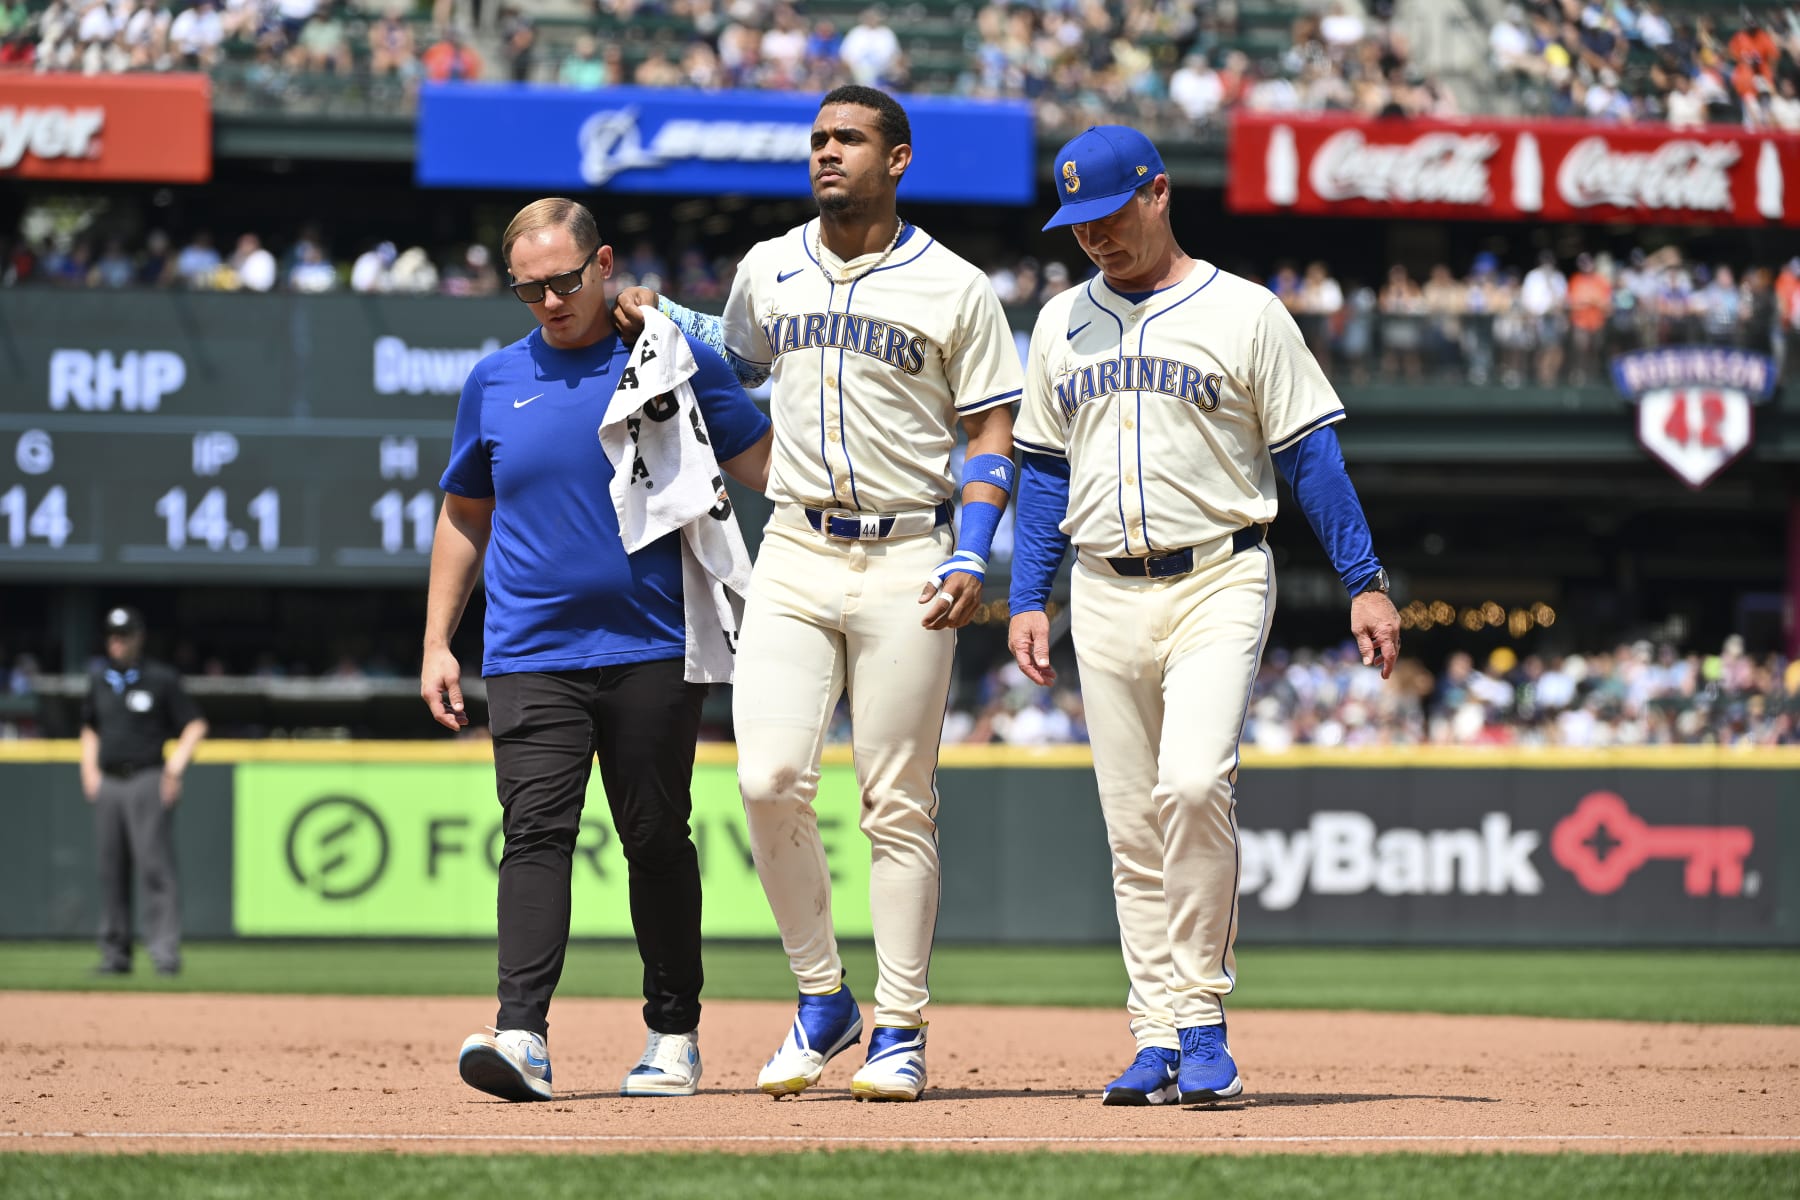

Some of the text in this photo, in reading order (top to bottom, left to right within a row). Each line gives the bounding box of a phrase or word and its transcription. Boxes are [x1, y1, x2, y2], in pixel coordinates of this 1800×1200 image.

[762, 311, 927, 376] MARINERS
[49, 349, 186, 412] RHP
[1055, 355, 1223, 426] MARINERS
[1664, 389, 1726, 449] 42
[192, 431, 240, 476] IP
[379, 434, 419, 480] H
[0, 484, 73, 549] 14
[155, 486, 280, 552] 14.1
[369, 489, 436, 555] 11
[862, 523, 877, 538] 44
[1238, 810, 1543, 911] eyBank
